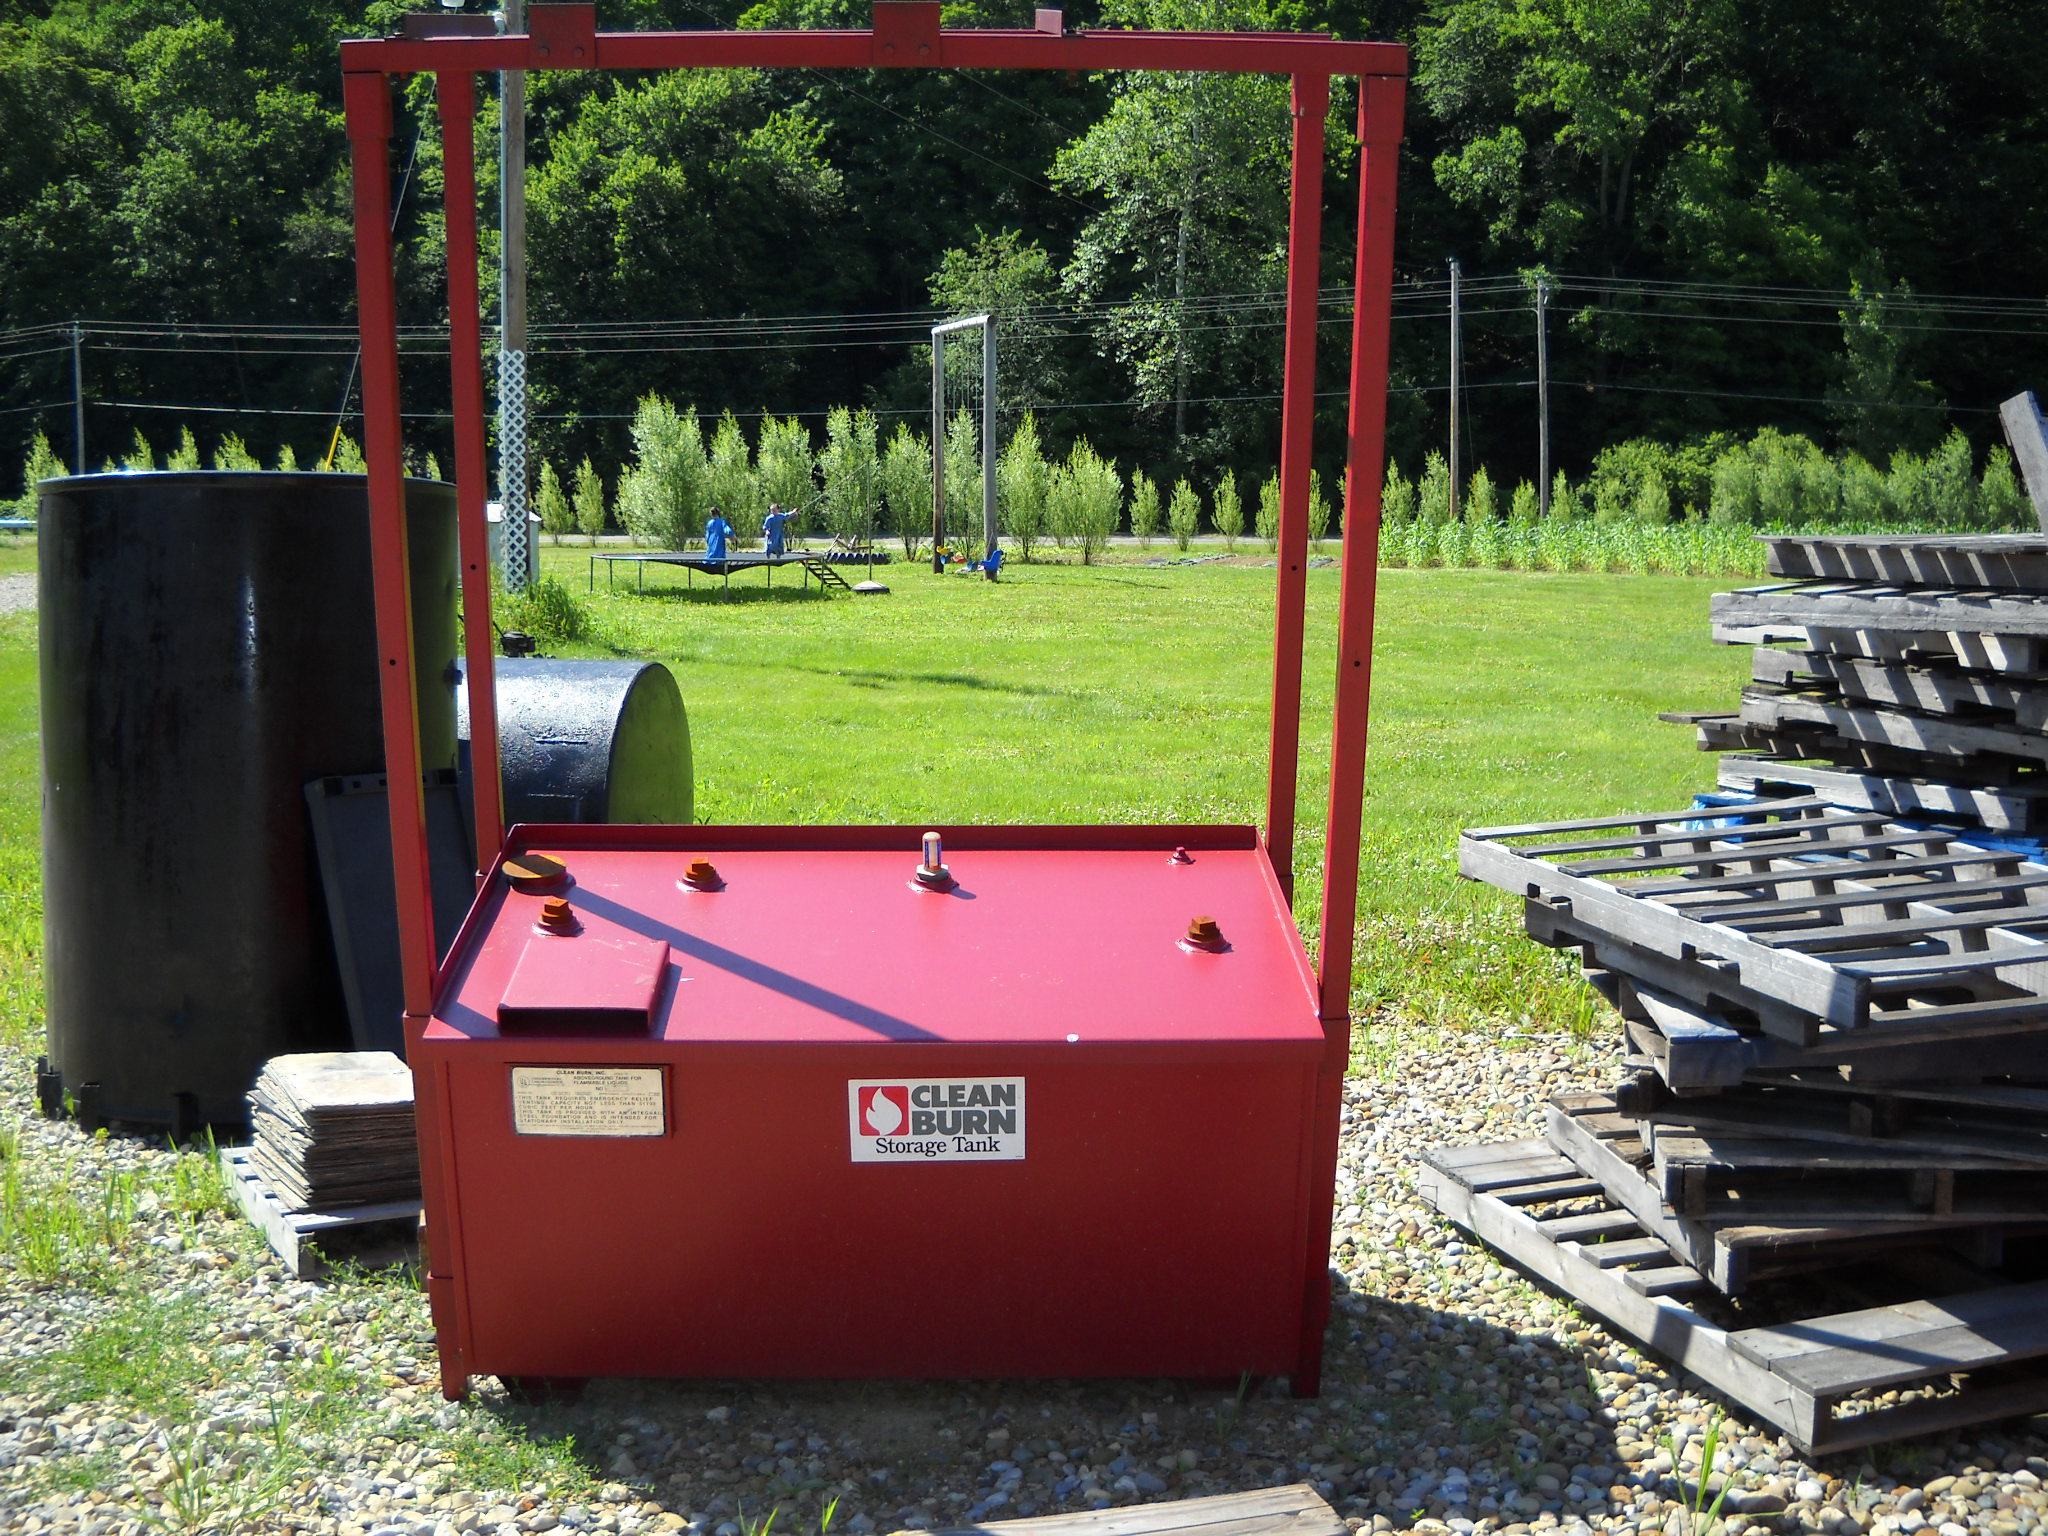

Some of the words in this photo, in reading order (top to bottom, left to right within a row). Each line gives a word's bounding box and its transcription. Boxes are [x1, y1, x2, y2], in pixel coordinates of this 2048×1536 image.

[911, 1084, 1016, 1108] CLEAN
[911, 1109, 1016, 1136] BURN
[876, 1137, 946, 1158] Storage
[952, 1136, 1000, 1154] Tank
